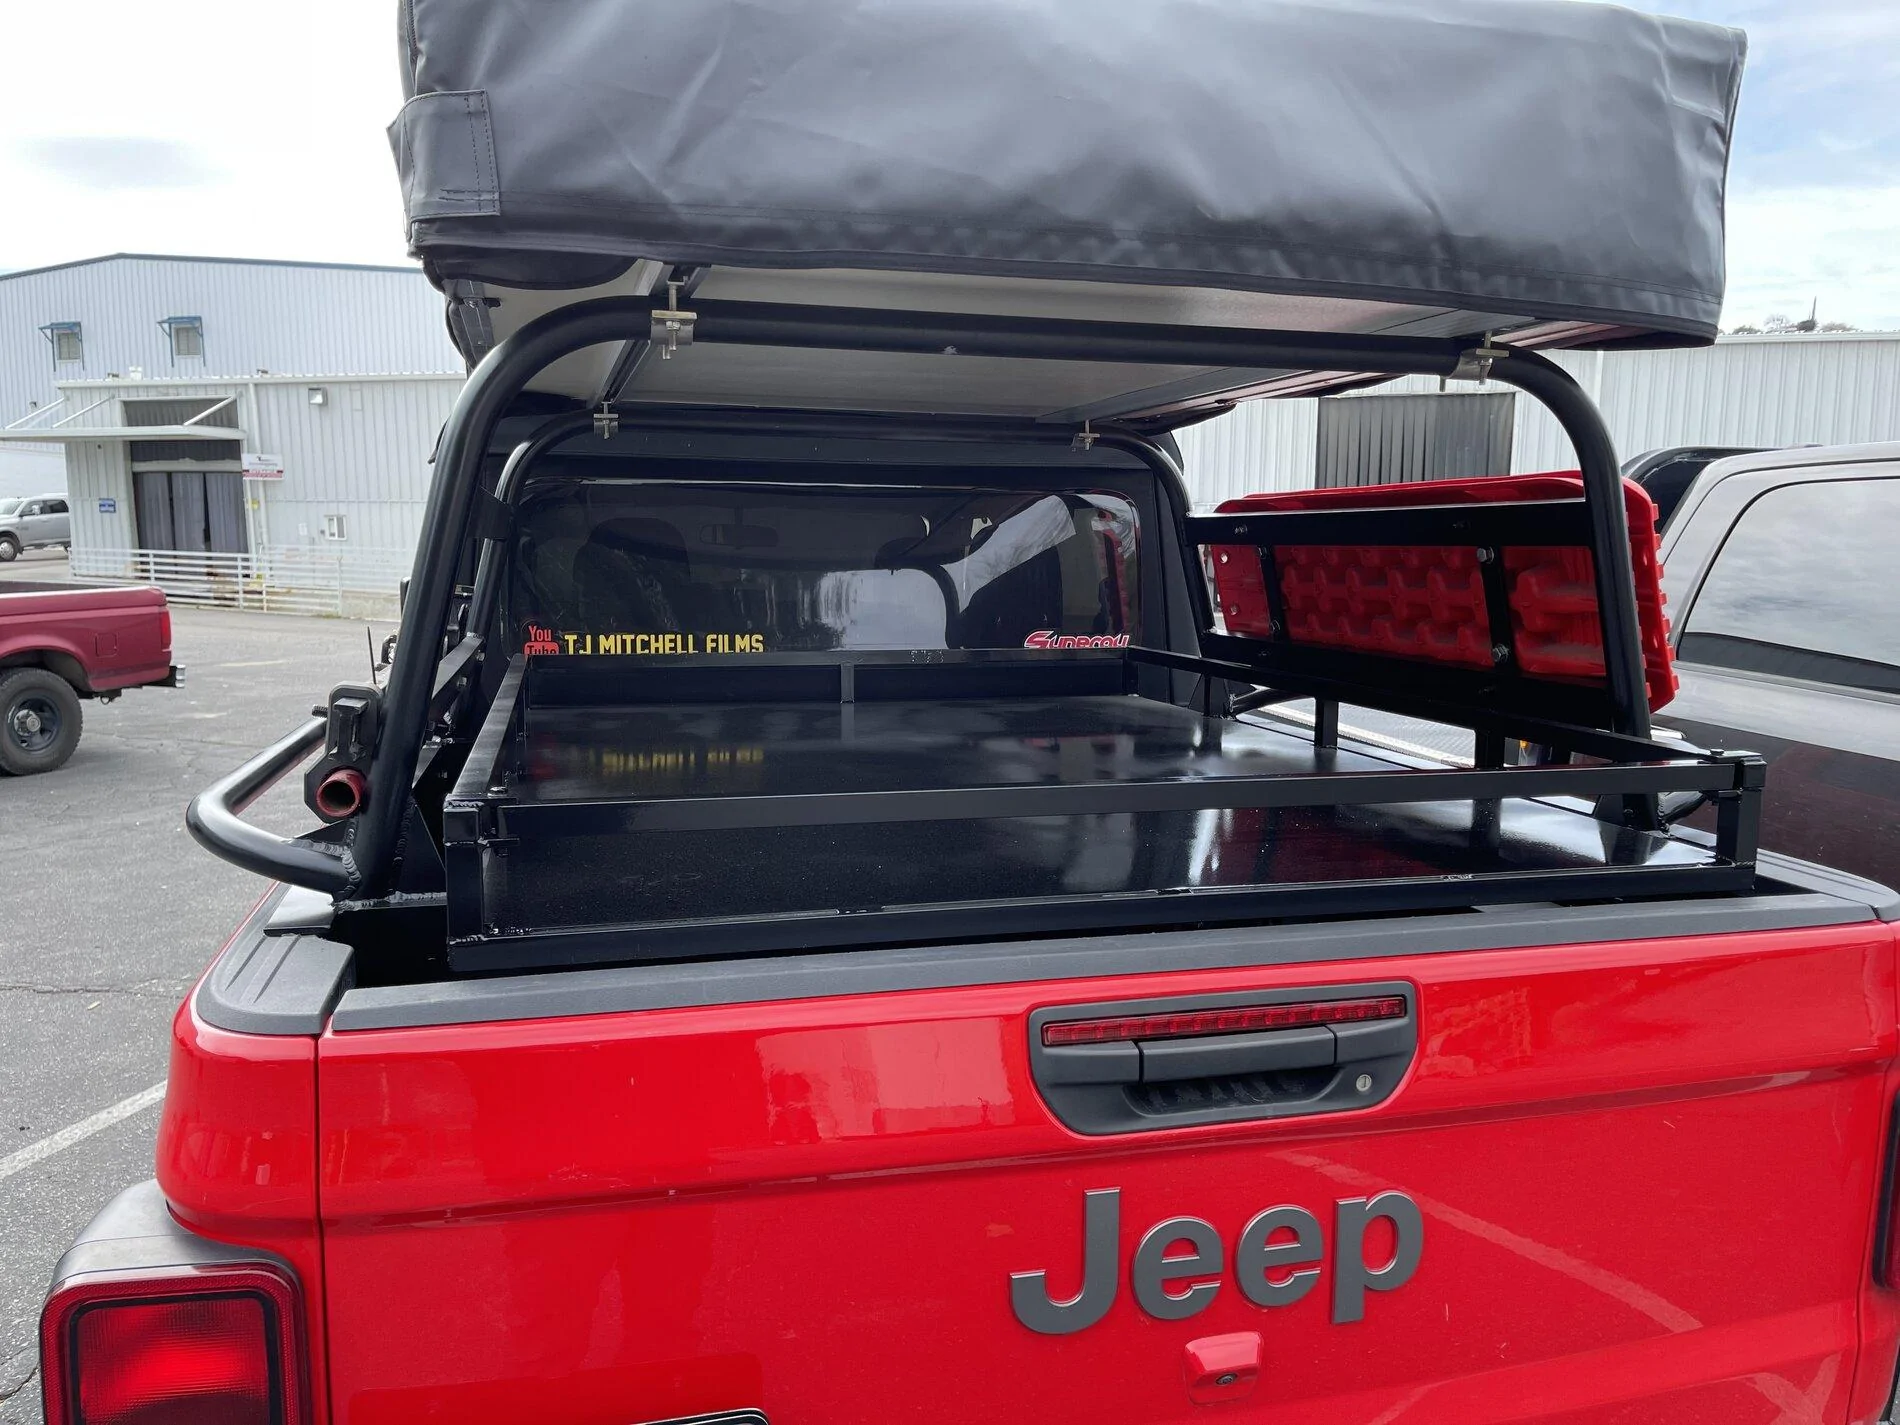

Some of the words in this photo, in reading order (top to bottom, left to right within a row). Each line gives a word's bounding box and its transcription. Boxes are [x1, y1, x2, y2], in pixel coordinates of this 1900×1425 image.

[528, 625, 552, 642] You
[564, 634, 592, 655] TJ
[599, 634, 699, 655] MITCHELL
[706, 633, 764, 654] FILMS
[1009, 1186, 1424, 1336] Jeep
